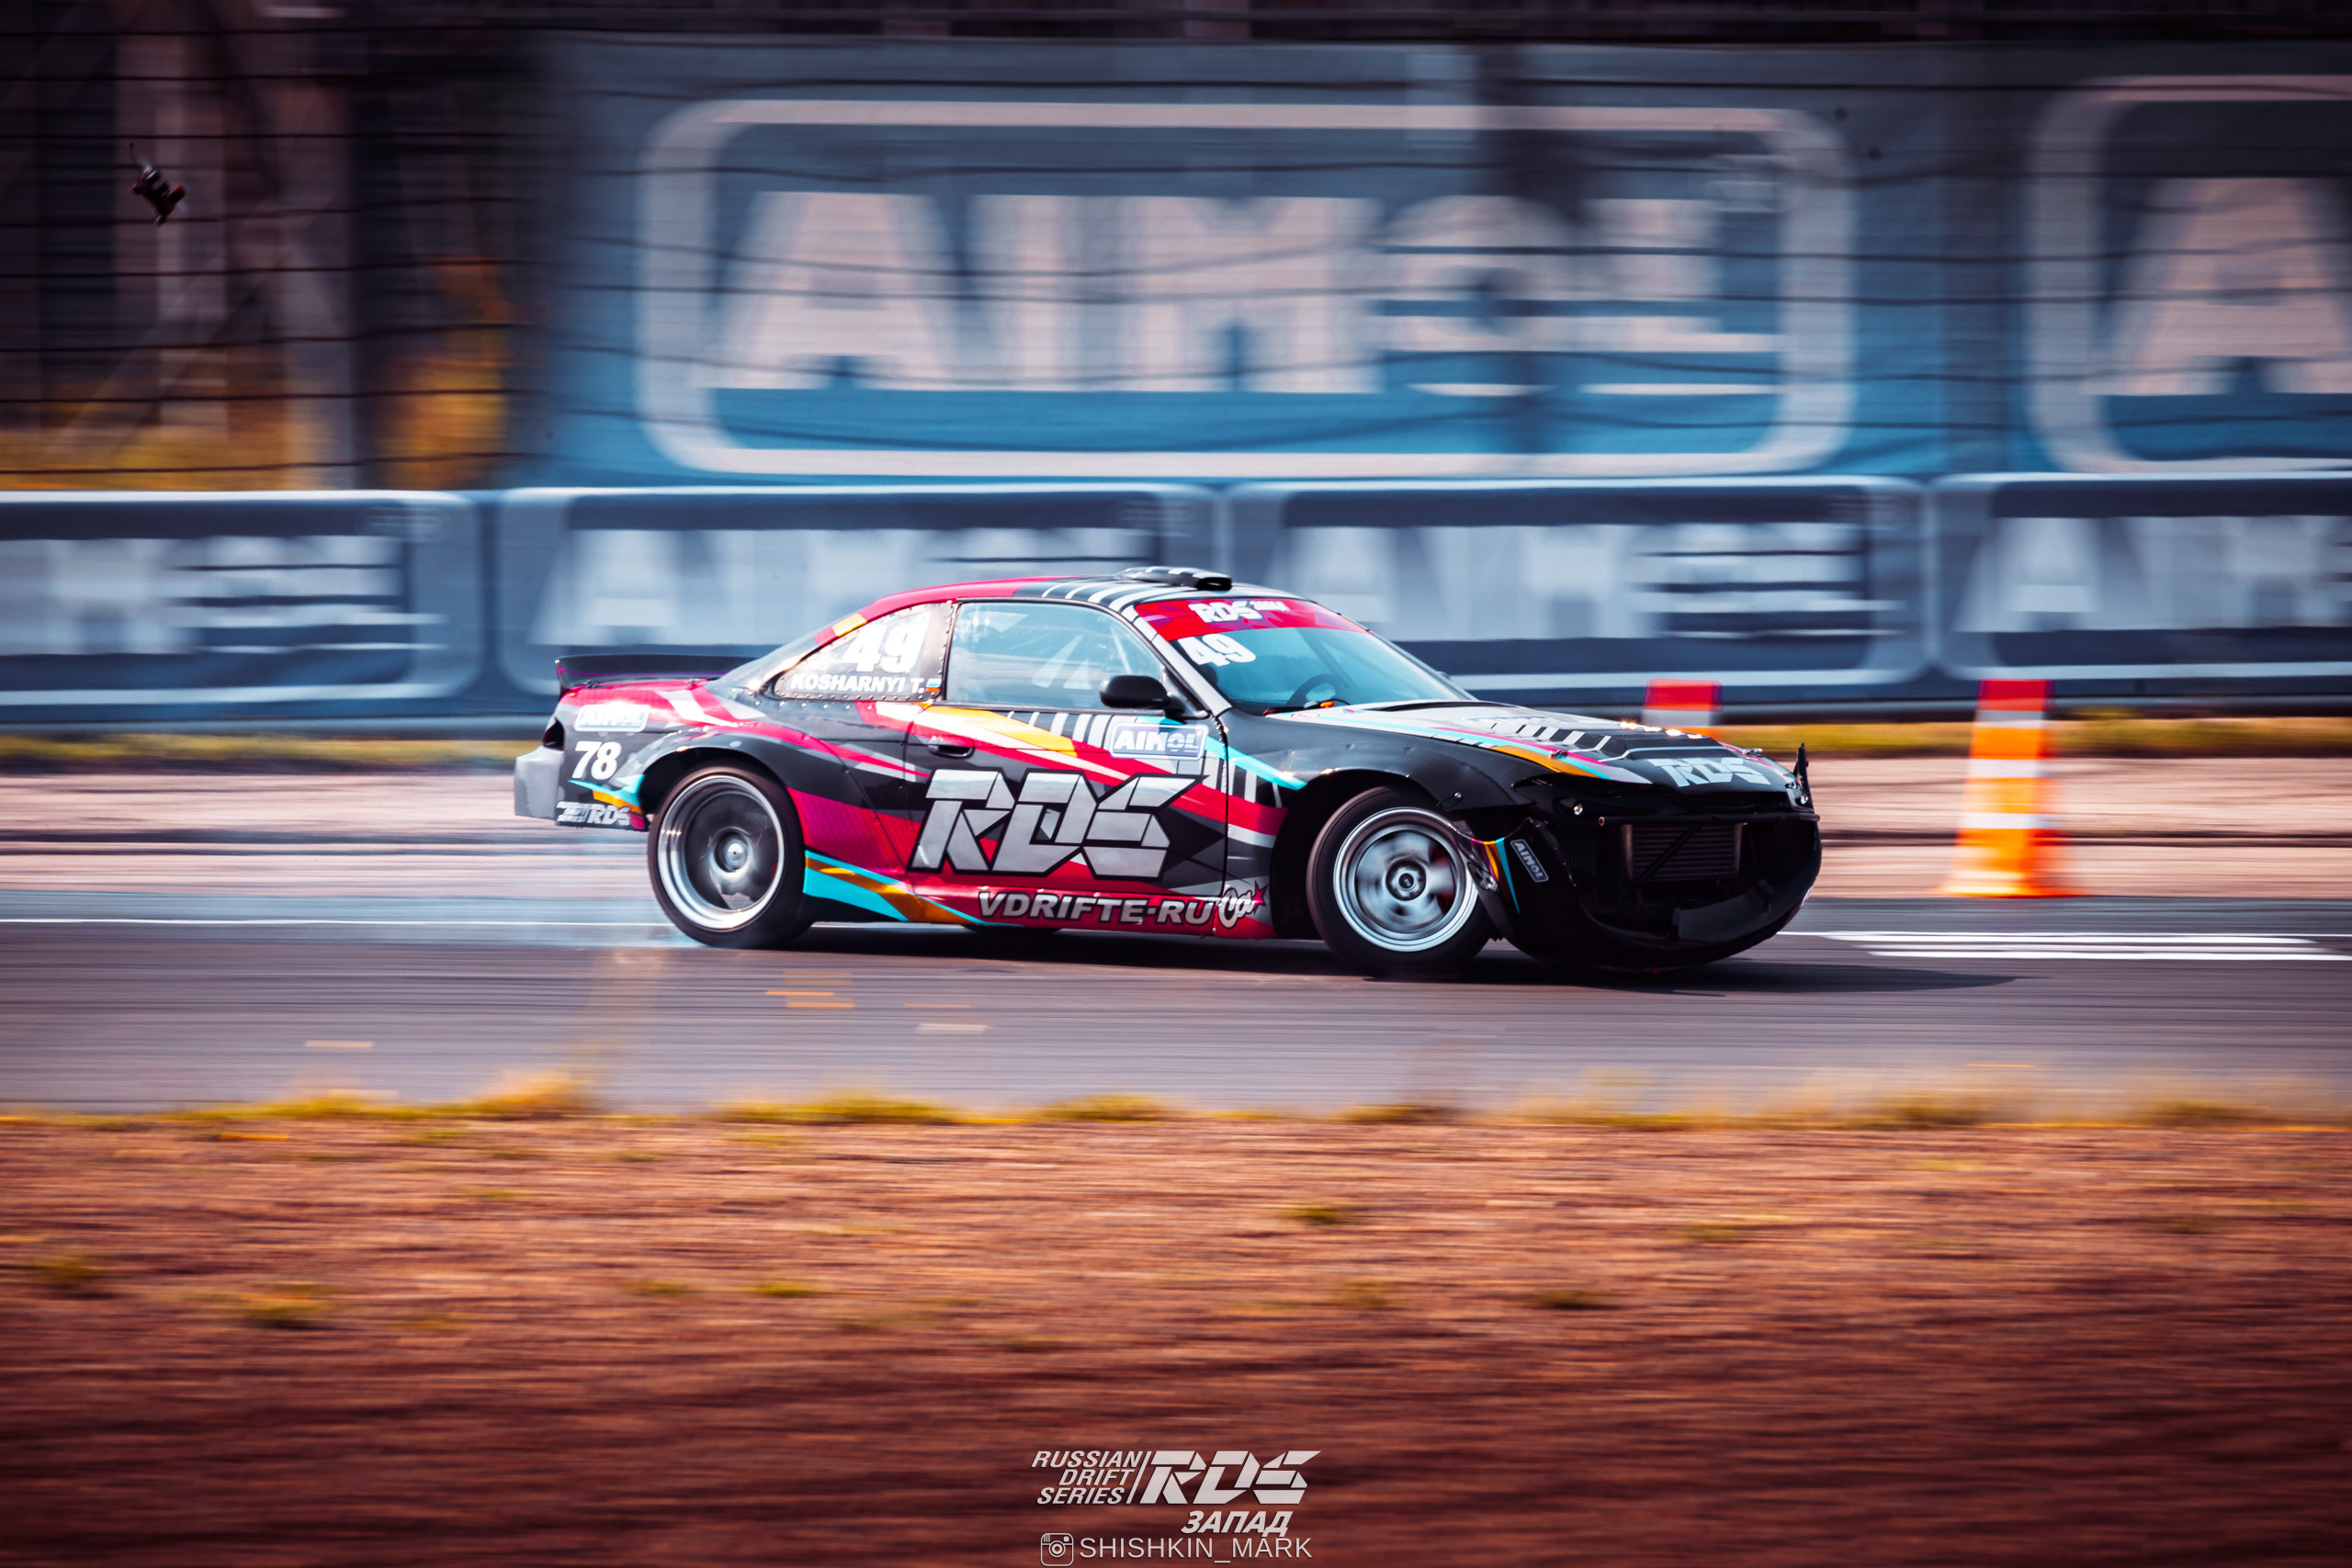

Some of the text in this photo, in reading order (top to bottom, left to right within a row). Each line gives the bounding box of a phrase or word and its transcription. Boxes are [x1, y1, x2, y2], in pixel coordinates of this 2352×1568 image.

[1188, 600, 1262, 623] RDS
[843, 625, 922, 672] 49
[1177, 633, 1257, 667] 49
[790, 673, 907, 694] KOSHARNYI
[1114, 730, 1199, 752] AIMOL
[571, 740, 623, 780] 78
[1646, 757, 1771, 787] RDS
[909, 768, 1196, 880] RDS
